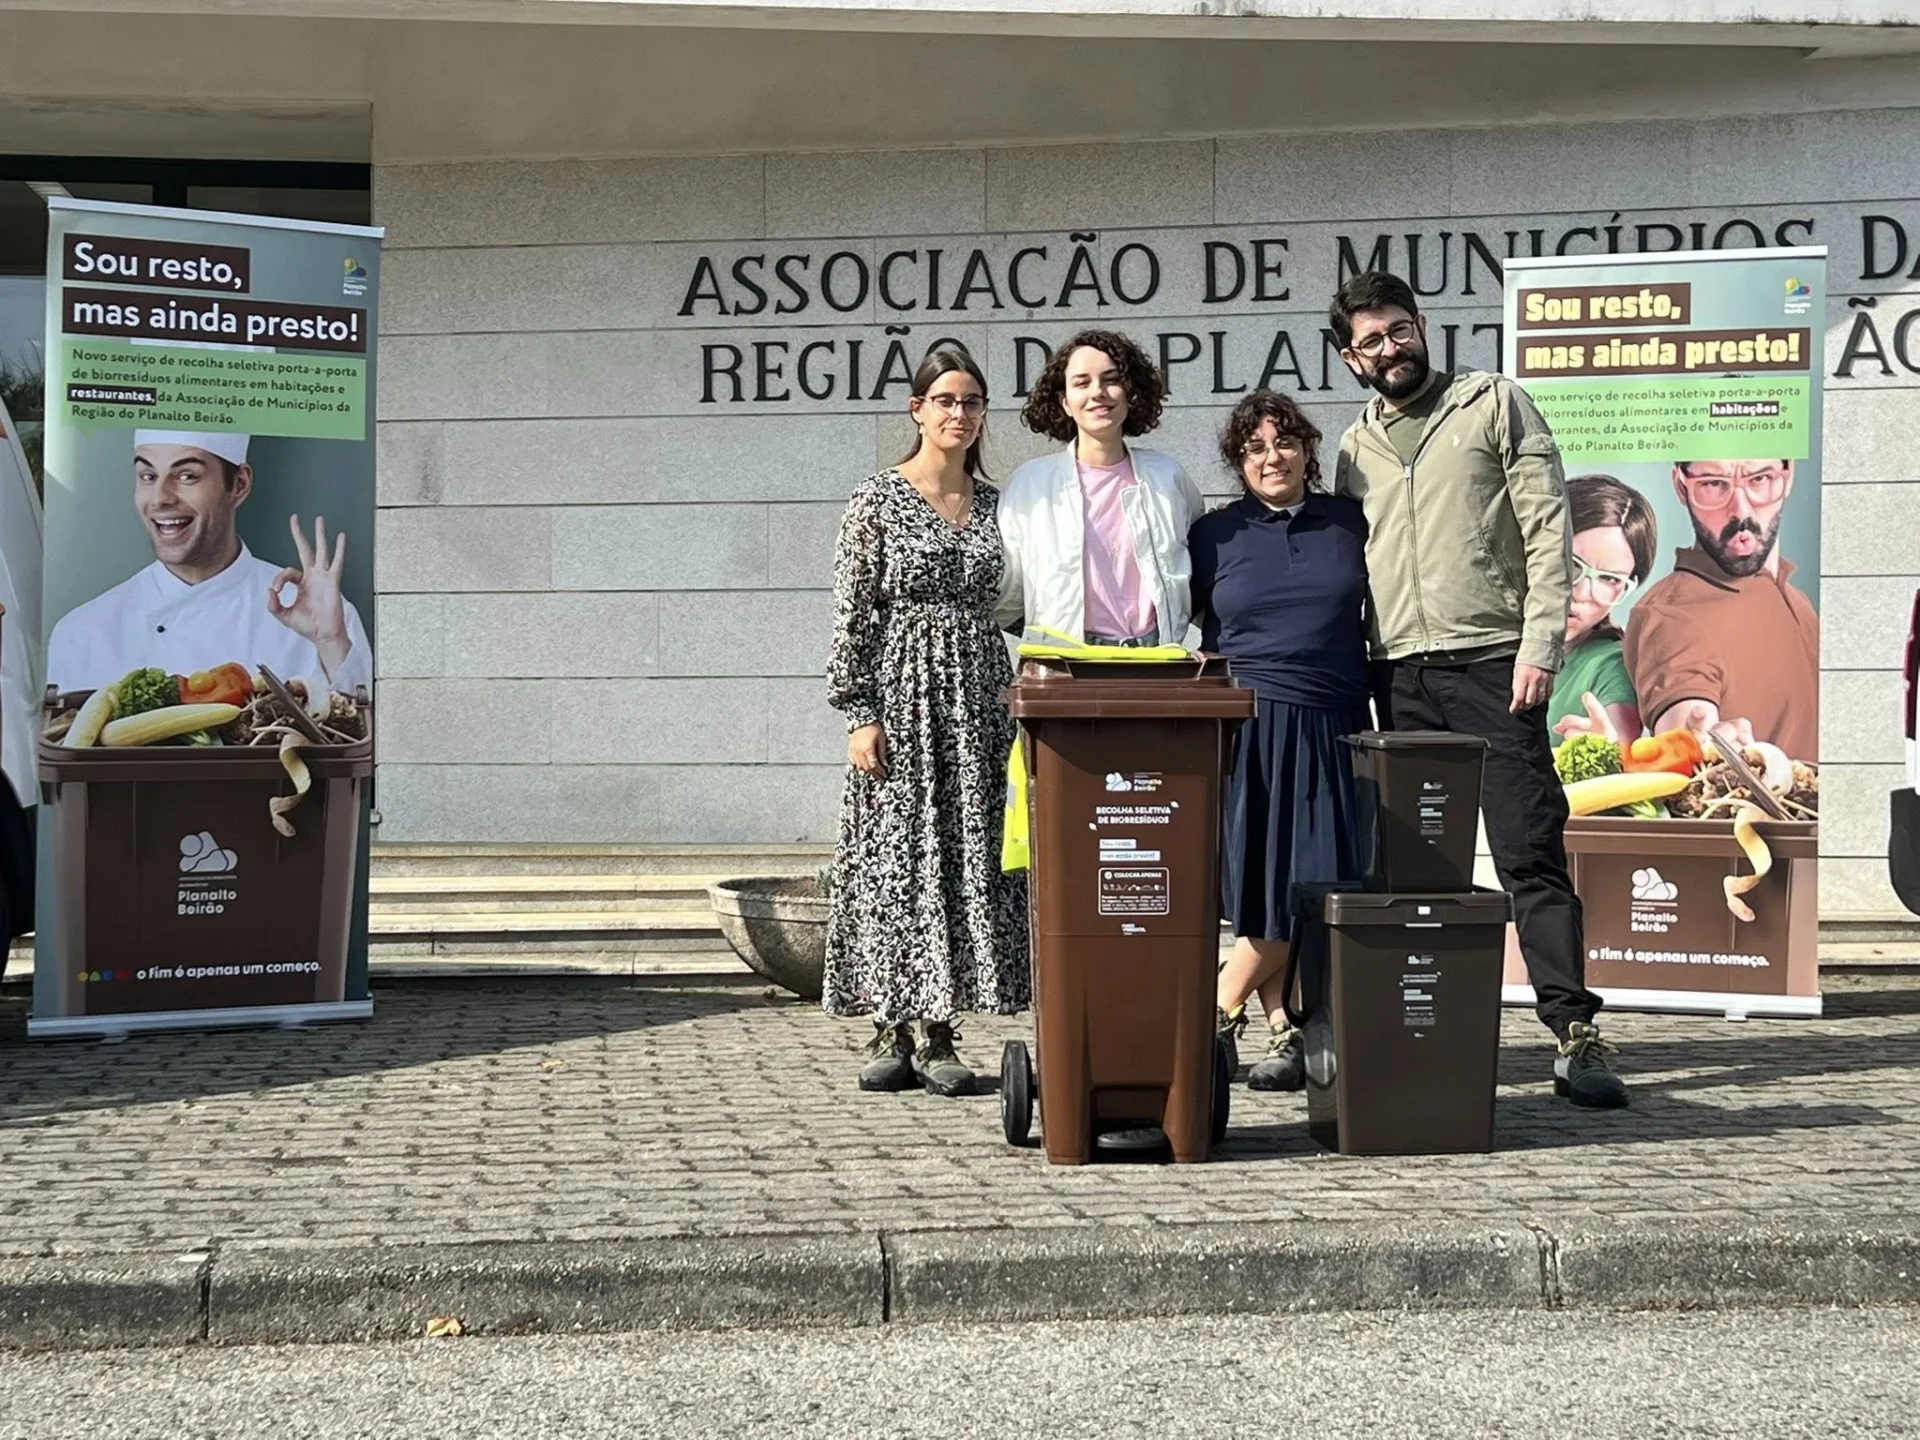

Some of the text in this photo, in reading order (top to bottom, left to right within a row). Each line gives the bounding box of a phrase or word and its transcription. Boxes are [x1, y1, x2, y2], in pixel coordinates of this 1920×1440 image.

[74, 242, 242, 289] Sou resto,
[1203, 239, 1290, 304] DE
[1526, 289, 1681, 322] Sou resto,
[73, 300, 358, 342] mas ainda presto!
[1525, 345, 1584, 370] mas
[1593, 336, 1677, 369] ainda
[1685, 332, 1800, 369] presto!
[73, 349, 357, 378] Novo serviço de recolha seletiva porta-a-porta
[700, 325, 970, 403] REGIÃ
[72, 368, 345, 395] de biorresíduos alimentares em habitações e
[71, 388, 350, 414] restaurantes, da Associação de Municípios da
[1560, 390, 1602, 405] serviço
[1605, 389, 1619, 401] de
[1623, 388, 1665, 401] recolha
[1669, 387, 1715, 400] seletiva
[1719, 386, 1800, 400] porta-a-porta
[72, 405, 236, 425] Região do Planalto Beirão.
[1543, 402, 1787, 419] biorresíduos alimentares em habitações e
[1603, 423, 1618, 435] da
[1622, 421, 1686, 435] Associação
[1691, 420, 1705, 432] de
[1709, 418, 1774, 433] Municípios
[1779, 419, 1792, 430] da
[1568, 440, 1582, 452] do
[1586, 439, 1634, 452] Planalto
[1638, 437, 1678, 451] Beirão.
[1096, 806, 1171, 814] RECOLHA SELETIVA
[178, 888, 237, 902] Planalto
[178, 902, 224, 915] Beirão
[1631, 911, 1679, 923] Planalto
[1631, 922, 1669, 933] Beirão
[1589, 947, 1770, 968] o fim é apenas um começo.
[136, 960, 321, 981] o fim é apenas um começo.
